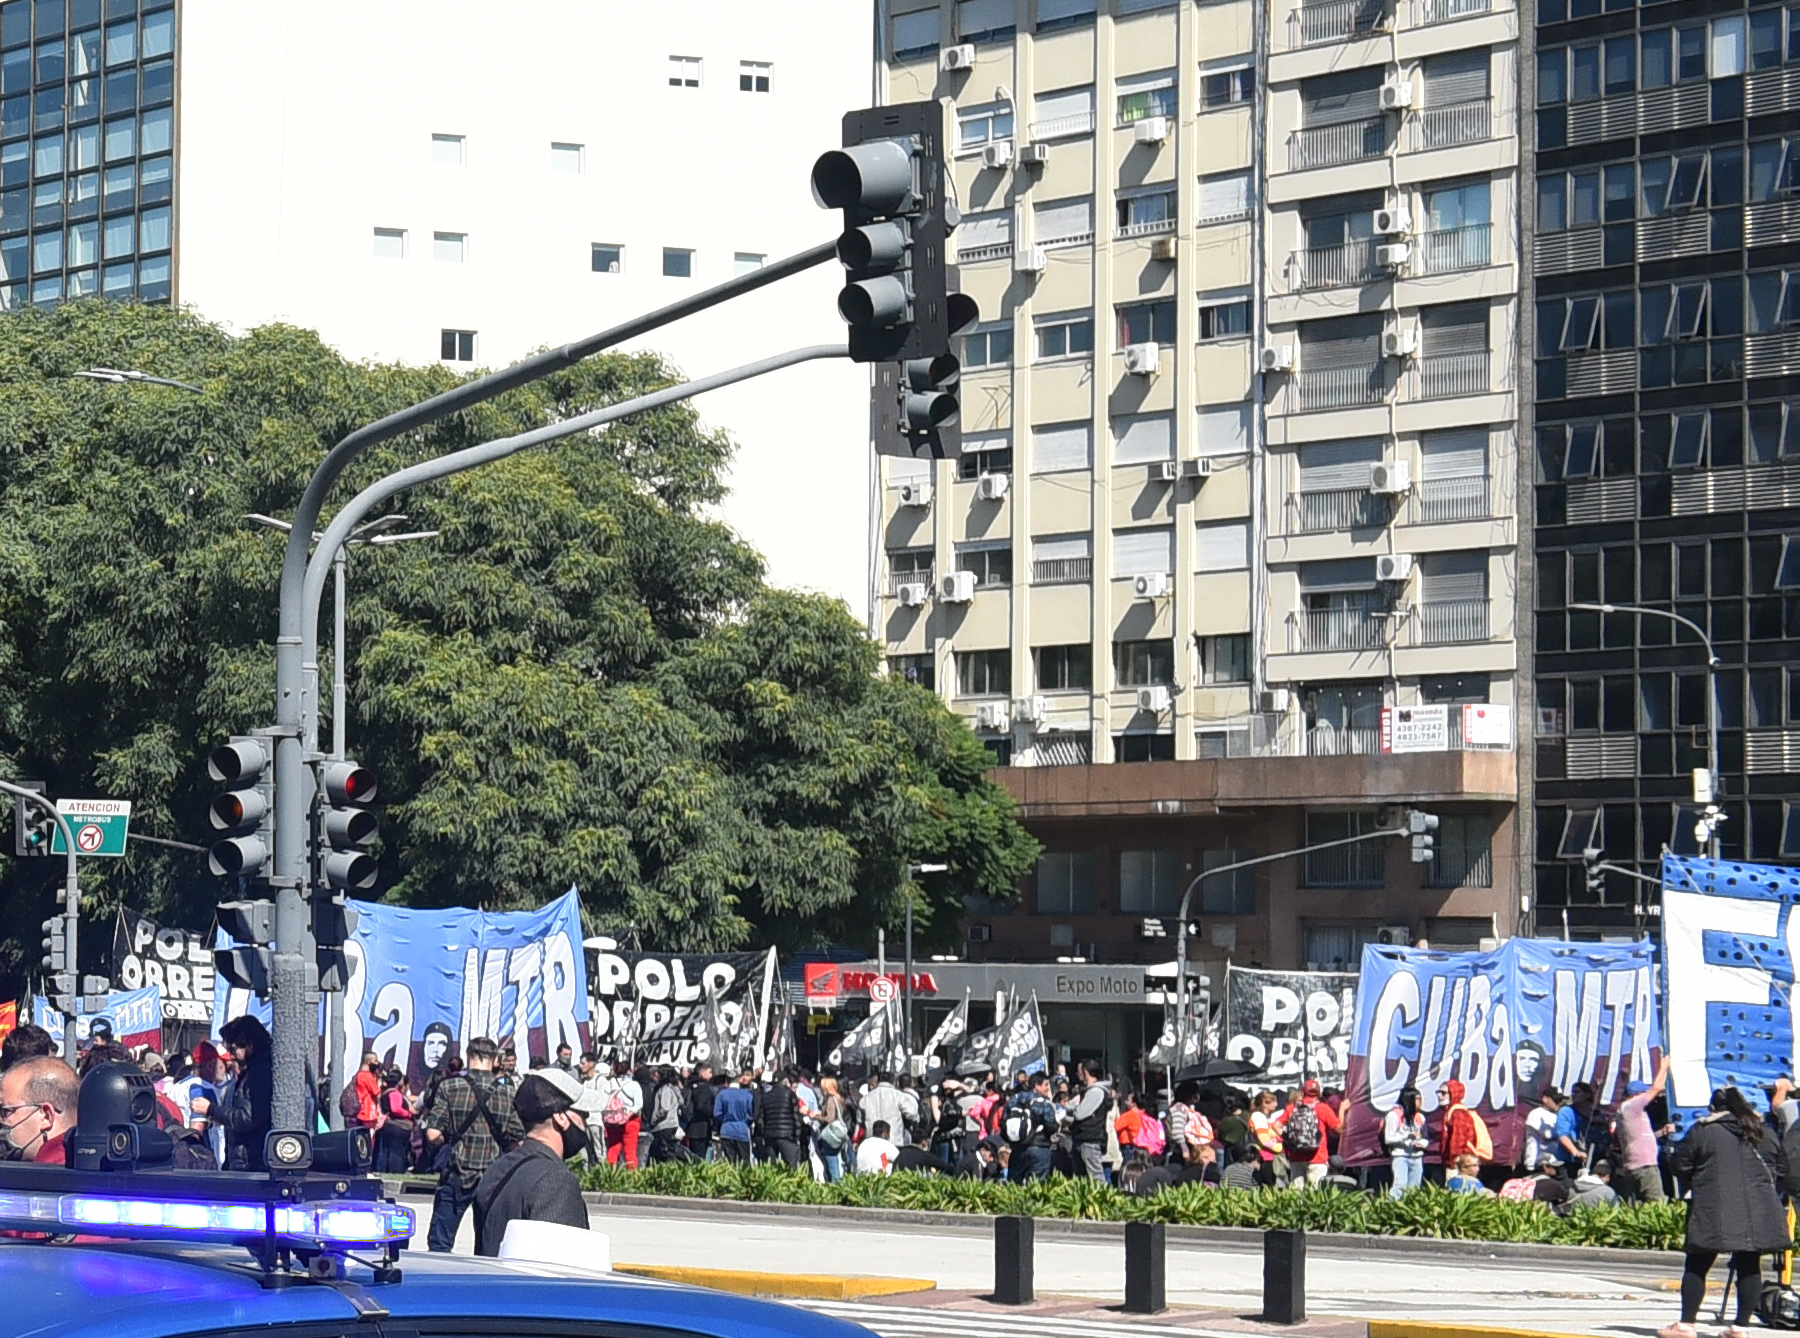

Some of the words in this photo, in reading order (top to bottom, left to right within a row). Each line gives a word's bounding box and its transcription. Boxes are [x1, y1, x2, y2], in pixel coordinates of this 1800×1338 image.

[68, 802, 121, 813] ATENCION
[135, 919, 212, 962] POL
[122, 955, 215, 1001] OBRE
[598, 954, 736, 1001] POLO
[1057, 975, 1095, 996] Expo
[1100, 976, 1138, 994] Moto
[116, 997, 154, 1029] MTR
[461, 930, 583, 1076] MTR
[1369, 970, 1515, 1113] CUBa
[1551, 966, 1653, 1105] MTR
